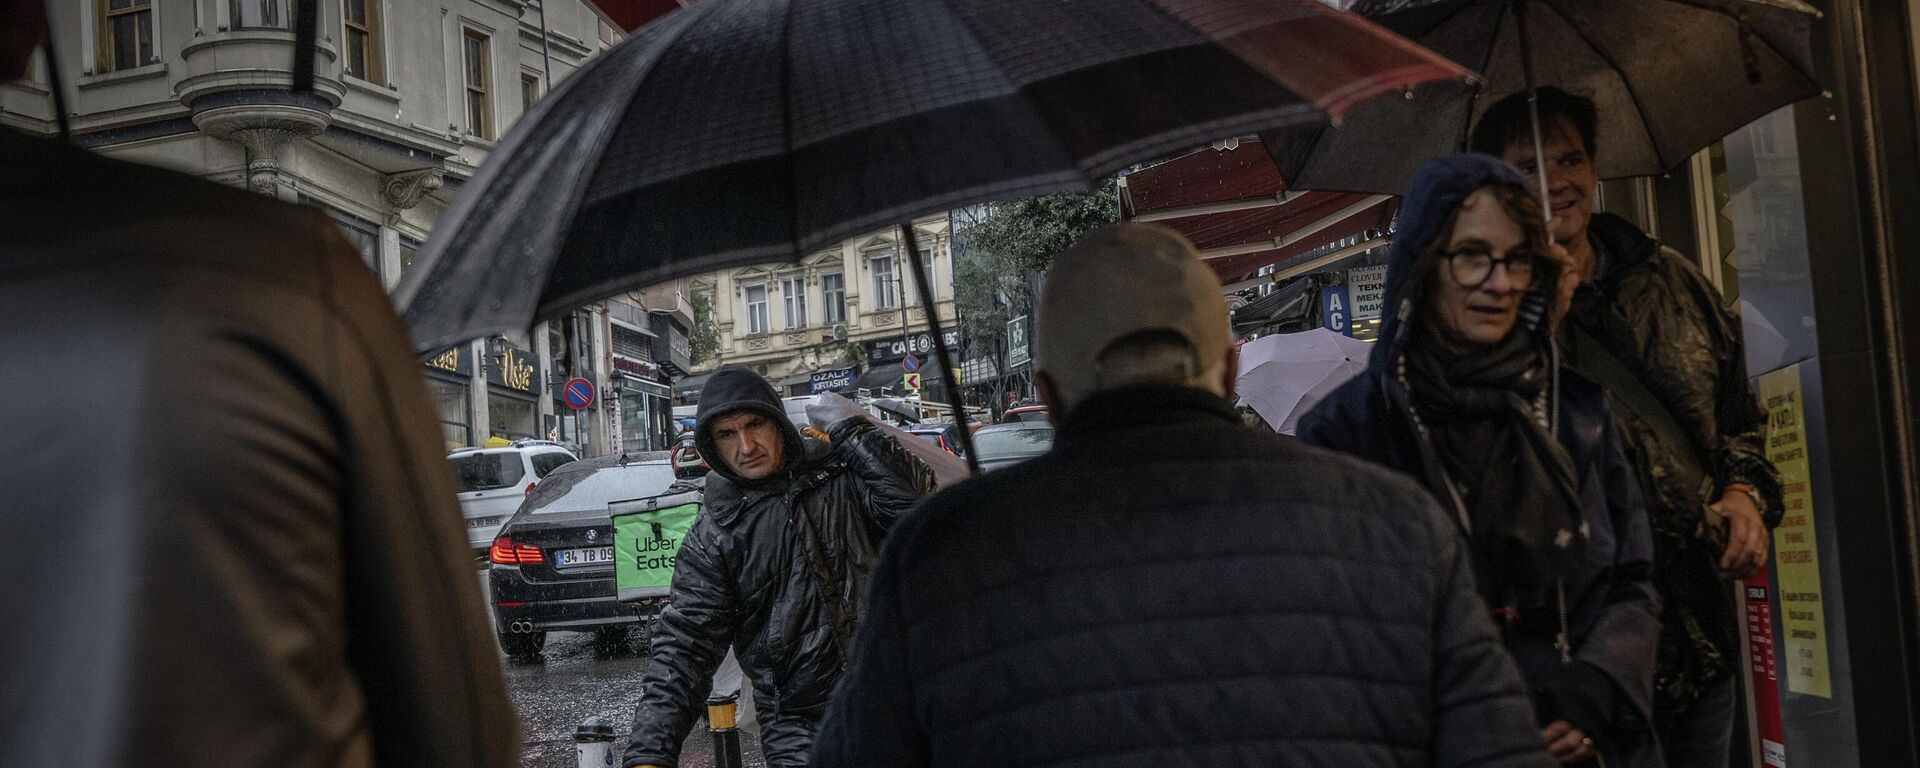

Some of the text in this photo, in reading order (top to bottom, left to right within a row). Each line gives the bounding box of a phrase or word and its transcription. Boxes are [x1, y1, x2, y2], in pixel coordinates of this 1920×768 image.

[1351, 273, 1383, 283] CLOVER
[892, 336, 917, 355] CAÉ
[635, 537, 677, 553] Uber
[564, 547, 614, 563] 34 TB 09
[636, 554, 677, 570] Eats
